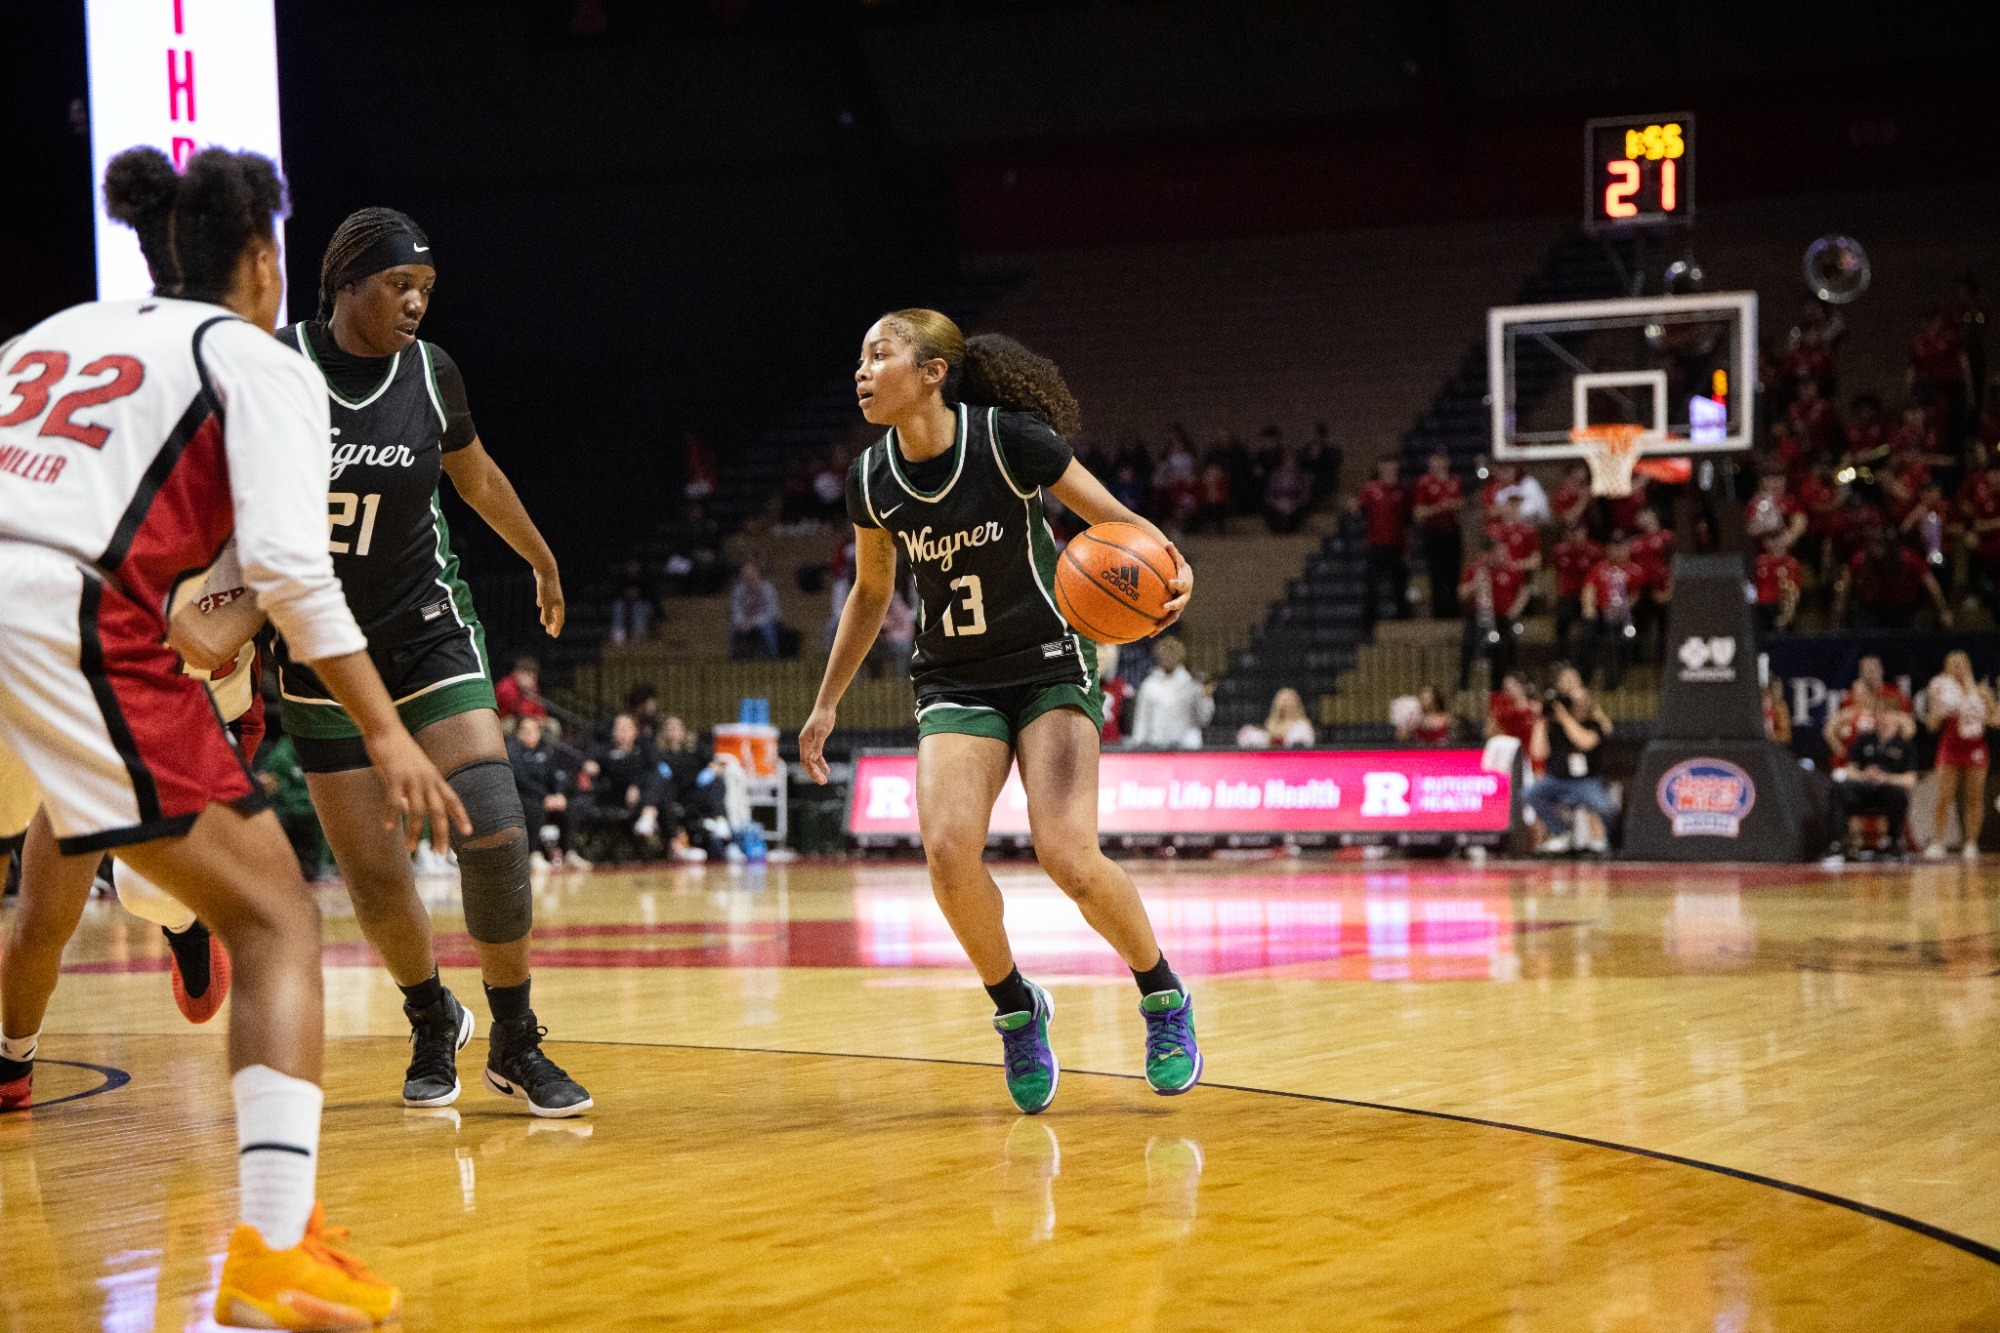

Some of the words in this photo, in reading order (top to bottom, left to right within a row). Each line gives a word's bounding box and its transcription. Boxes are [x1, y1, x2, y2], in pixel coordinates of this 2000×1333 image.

[1606, 159, 1676, 217] 21
[0, 350, 146, 451] 32
[328, 492, 381, 556] 21
[898, 521, 1003, 572] Wagner
[1101, 570, 1140, 601] adidas
[866, 776, 912, 819] R
[1168, 779, 1213, 811] Life
[1214, 779, 1262, 810] Into
[1264, 778, 1341, 809] Health
[1360, 772, 1411, 817] R
